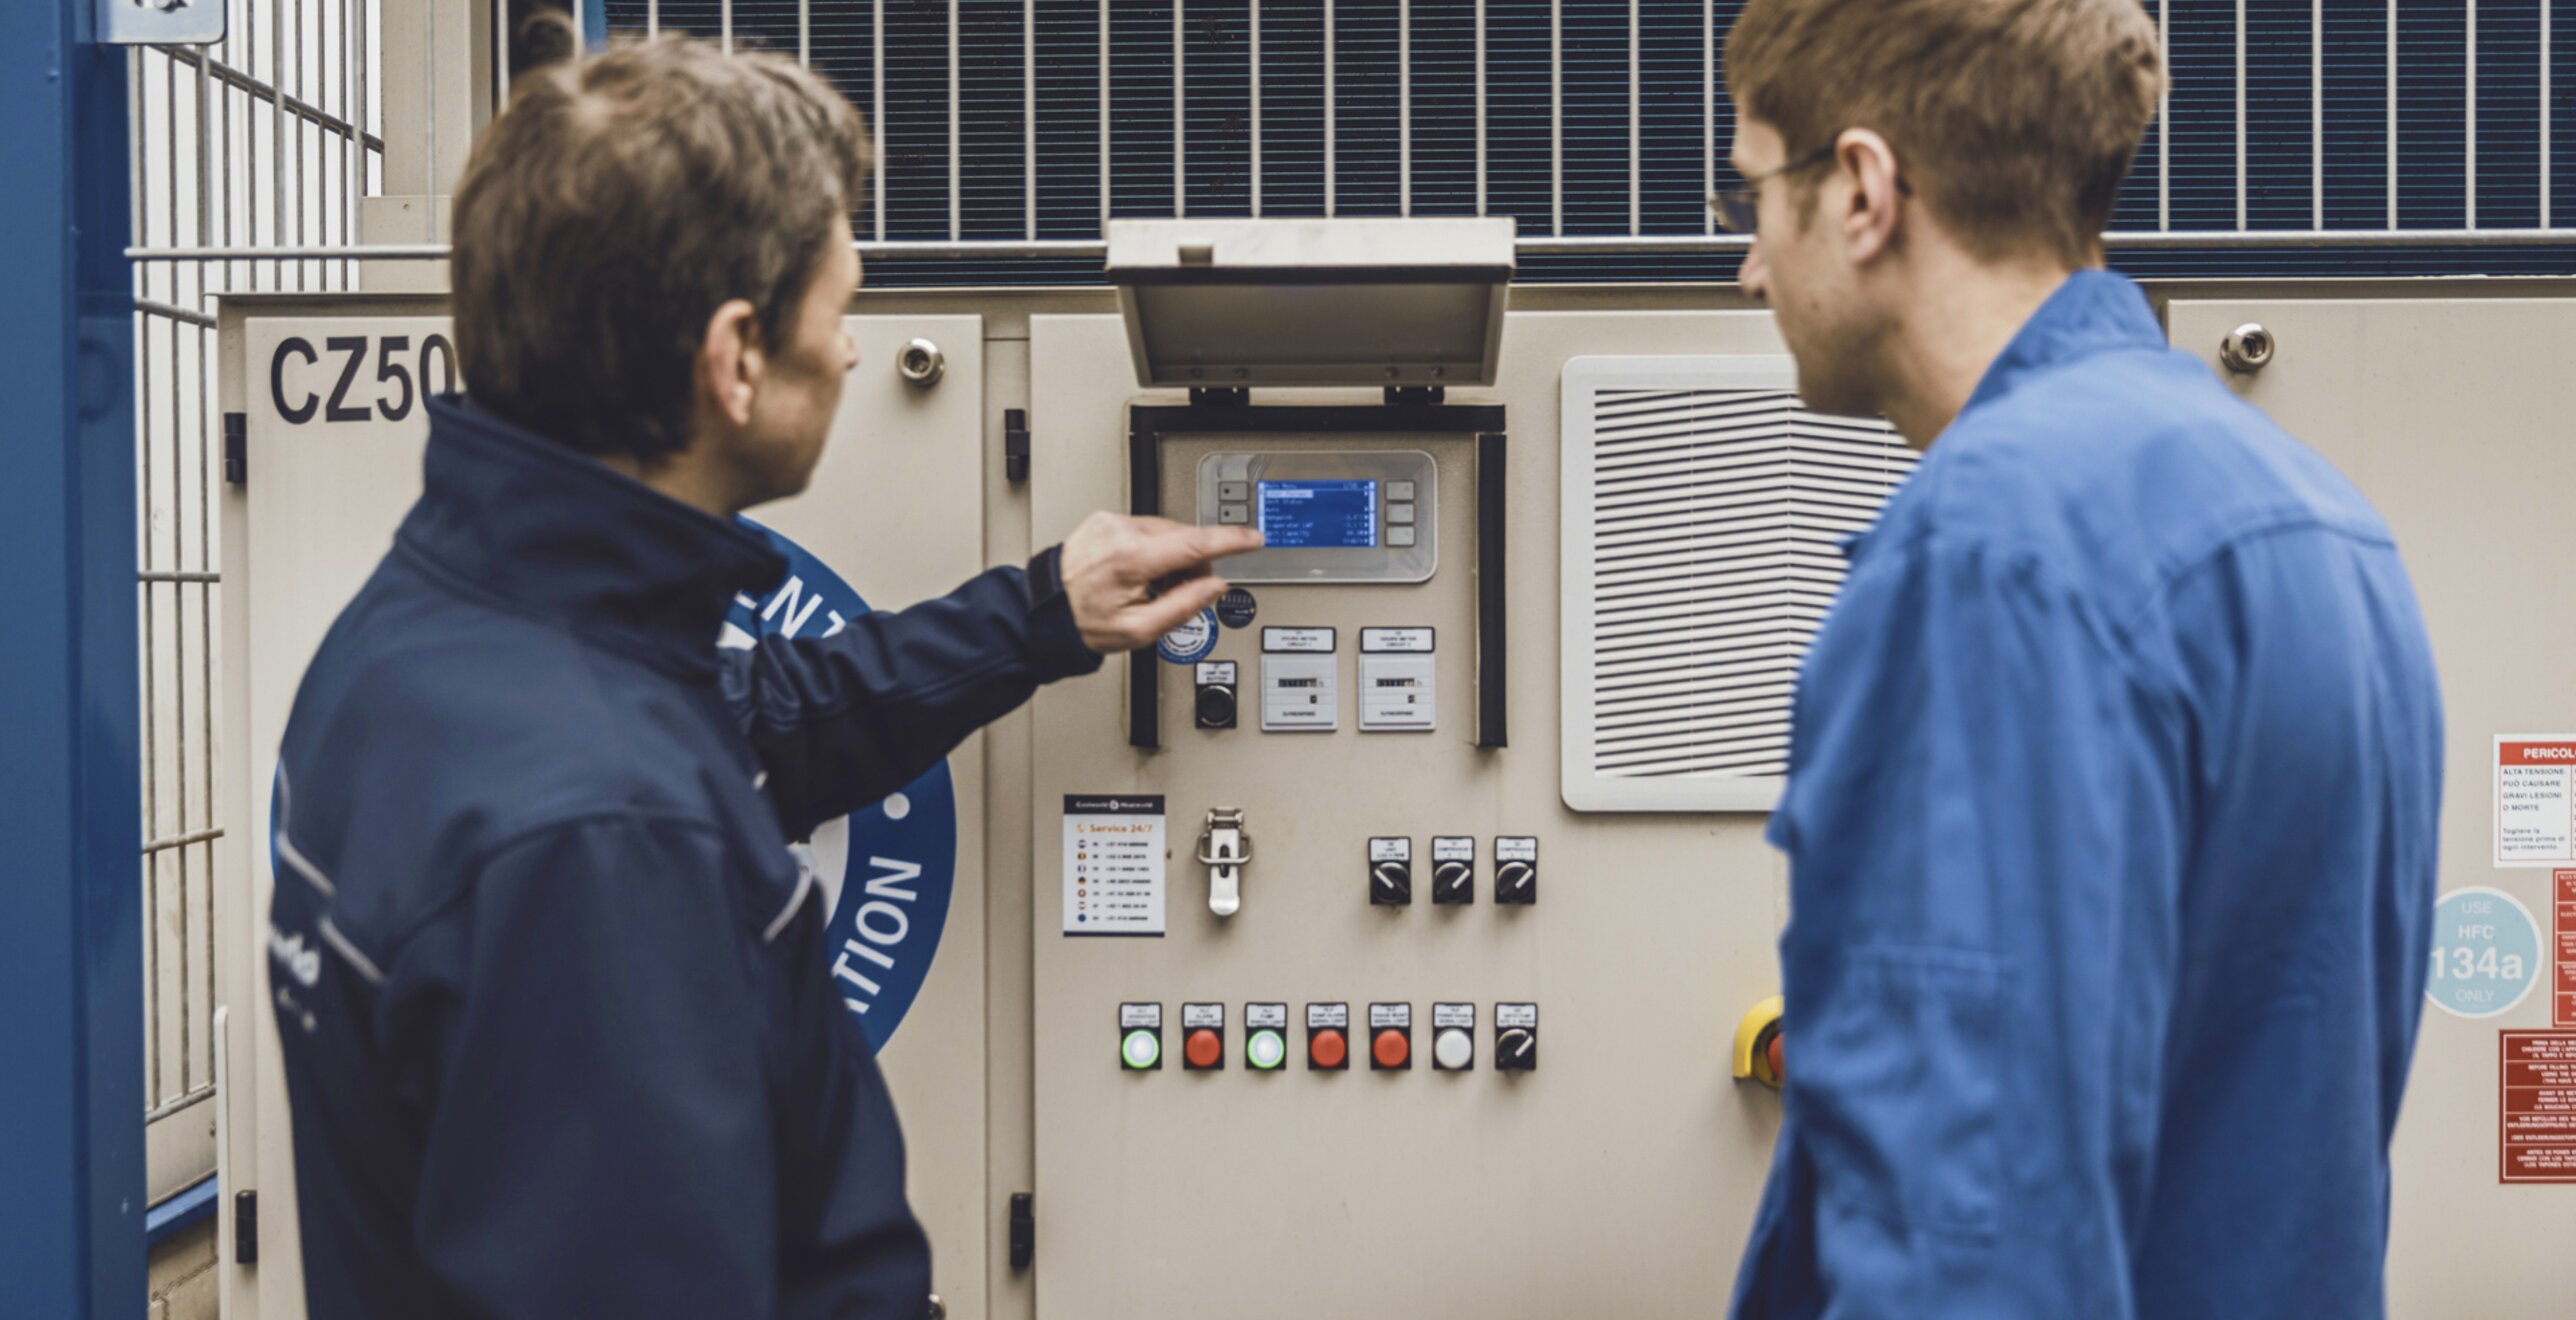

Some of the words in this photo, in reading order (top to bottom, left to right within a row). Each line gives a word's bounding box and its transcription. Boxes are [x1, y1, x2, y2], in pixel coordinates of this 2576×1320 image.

[2523, 748, 2576, 759] PERICOL
[1090, 824, 1127, 833] Service
[1130, 824, 1153, 833] 24/7
[2462, 902, 2492, 914] USE
[2458, 925, 2495, 939] HFC
[2431, 946, 2523, 980] 134a
[2456, 989, 2494, 1002] ONLY
